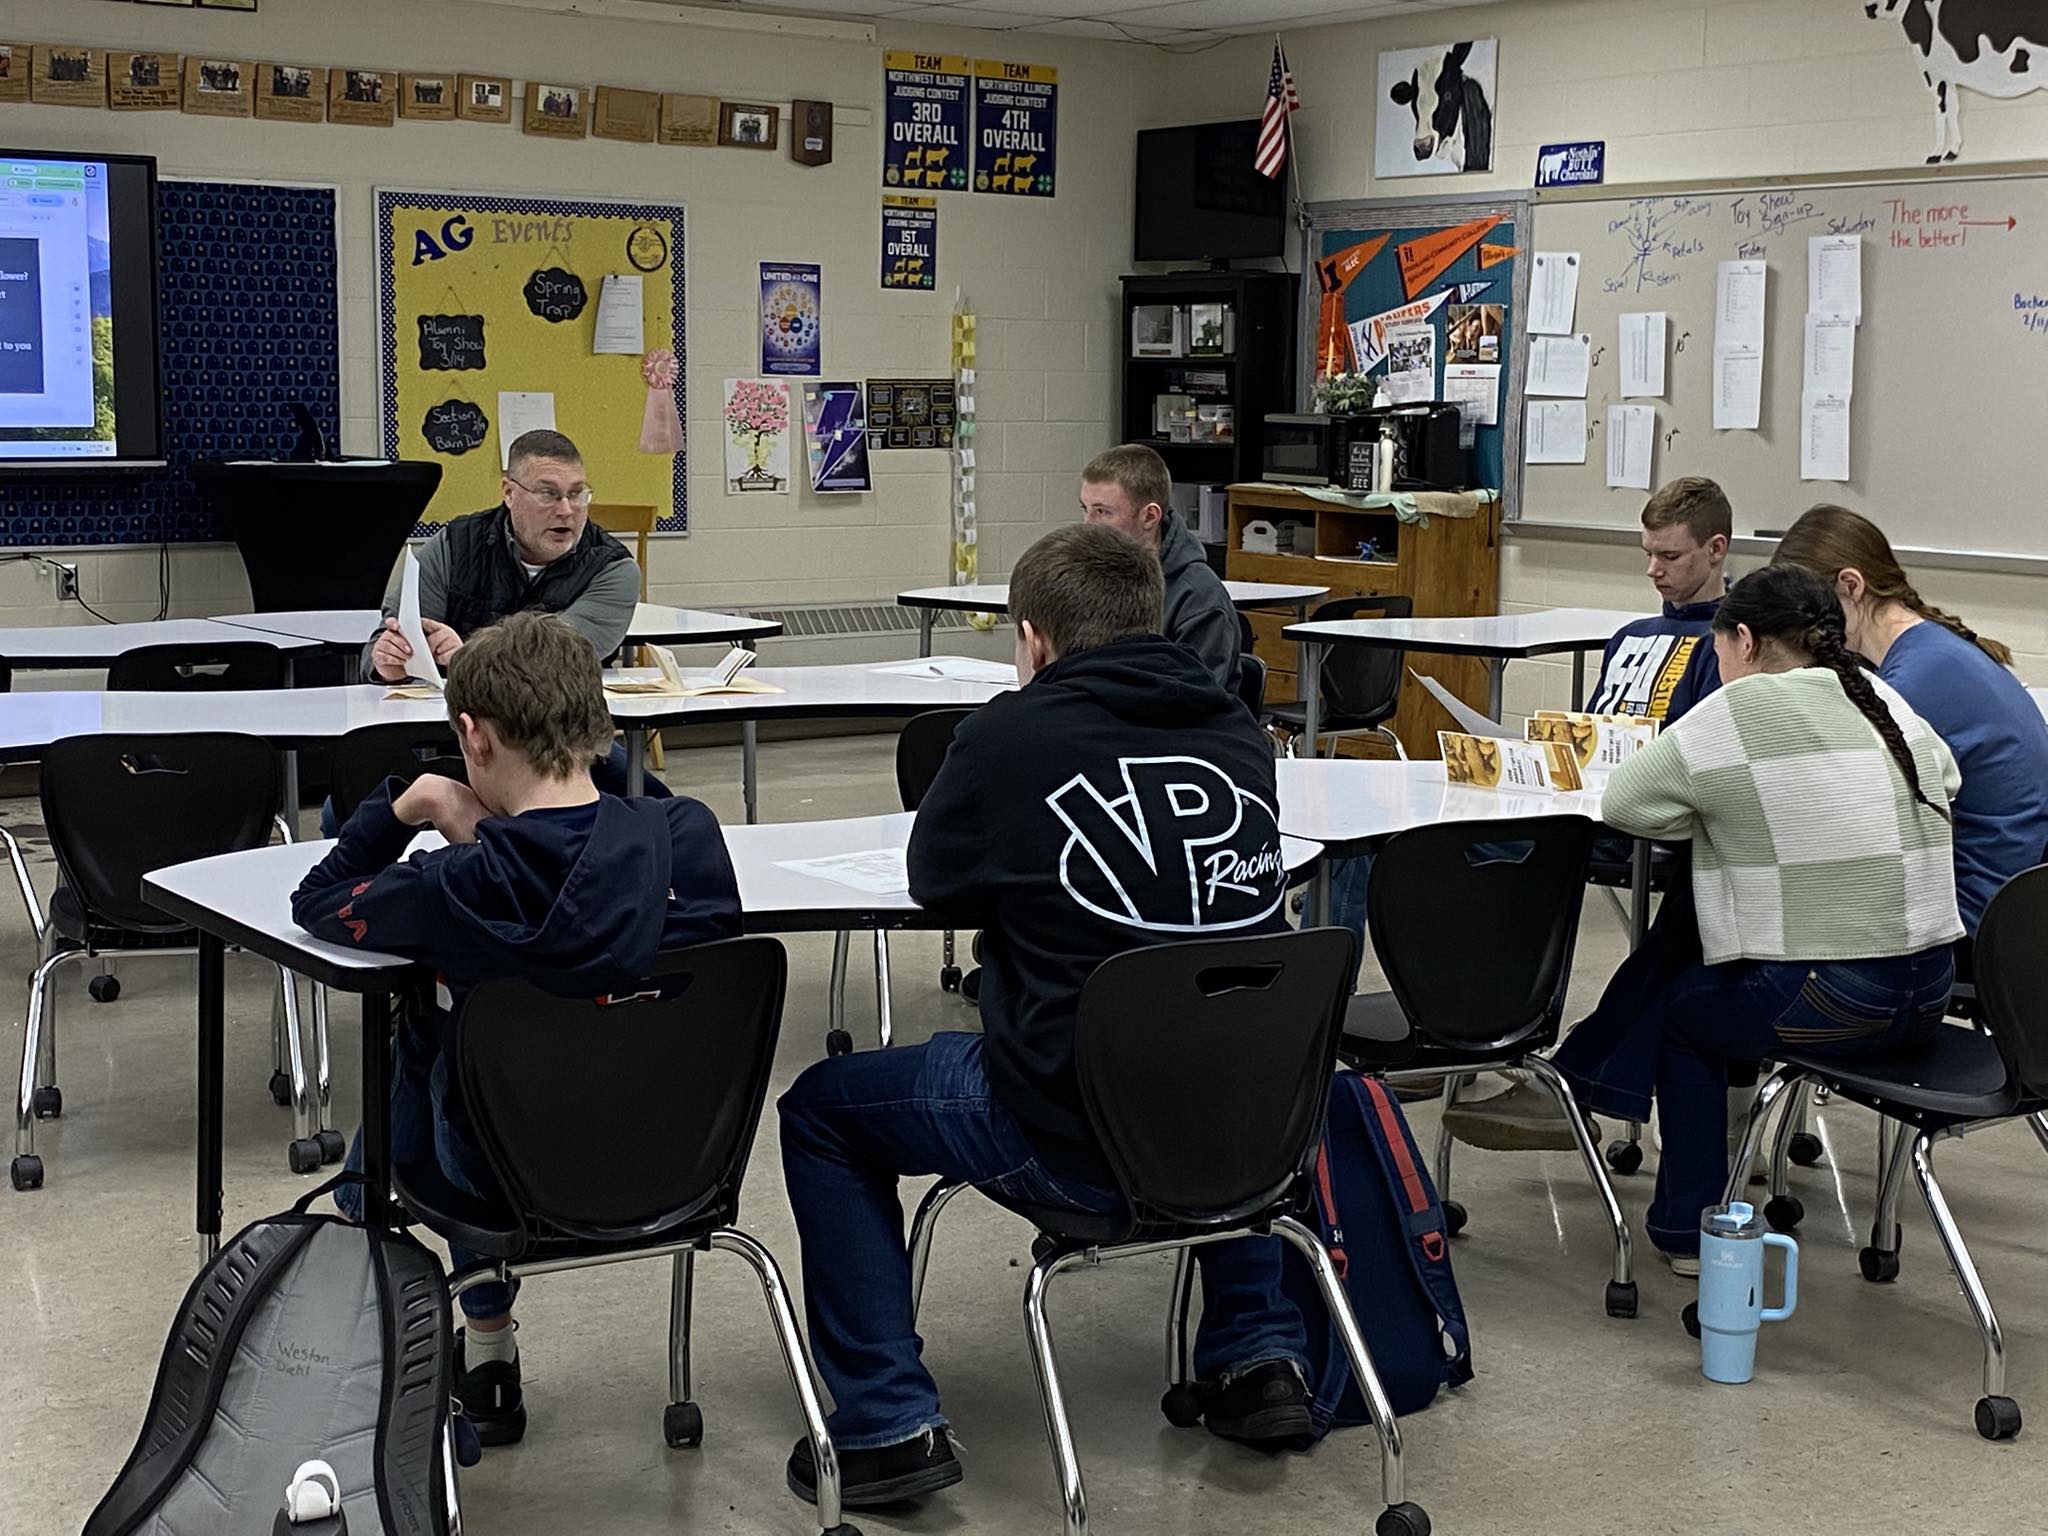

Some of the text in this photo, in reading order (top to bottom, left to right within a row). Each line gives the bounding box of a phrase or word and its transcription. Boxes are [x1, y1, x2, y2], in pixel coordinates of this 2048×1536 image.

[914, 55, 942, 70] TEAM
[1003, 63, 1031, 79] TEAM
[888, 71, 965, 87] NORTHWEST ILLINOIS
[978, 79, 1052, 95] NORTHWEST ILLINOIS
[893, 85, 960, 101] JUDGING CONTEST
[983, 93, 1048, 108] JUDGING CONTEST
[912, 102, 942, 123] 3RD
[1001, 110, 1030, 130] 4TH
[893, 122, 958, 145] OVERALL
[983, 129, 1046, 152] OVERALL
[901, 196, 919, 206] TEAM
[1730, 191, 1795, 228] Toy Show
[1882, 198, 1969, 225] The more
[1825, 211, 1876, 236] Saturday
[411, 214, 575, 267] AG Events
[901, 230, 917, 243] 1ST
[1888, 227, 1967, 248] the better!
[887, 242, 930, 257] OVERALL
[1737, 240, 1767, 260] Friday
[762, 271, 792, 281] UNITED
[801, 273, 818, 283] ONE
[533, 273, 582, 303] Spring
[535, 298, 573, 319] Trap
[423, 320, 466, 335] Alumni
[3, 341, 33, 352] to you
[428, 336, 484, 354] Toy Show
[439, 351, 465, 368] 3/14
[1045, 755, 1244, 933] VP
[1203, 841, 1284, 906] Racing
[277, 1340, 330, 1365] Weston
